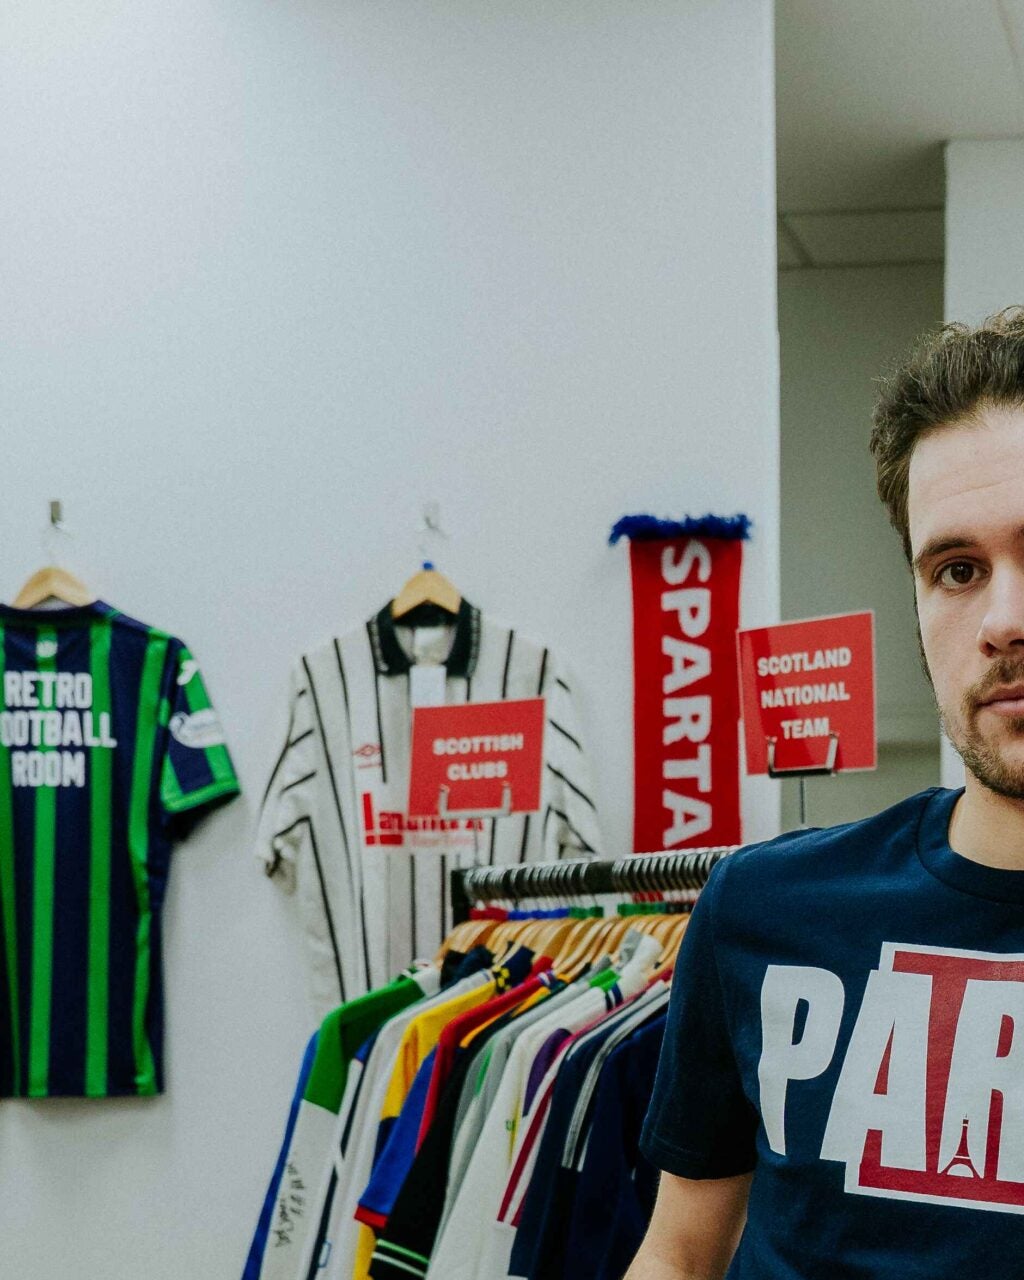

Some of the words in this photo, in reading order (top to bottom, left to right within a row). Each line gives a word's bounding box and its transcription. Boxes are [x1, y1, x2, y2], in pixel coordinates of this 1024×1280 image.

[757, 647, 852, 677] SCOTLAND
[4, 671, 93, 708] RETRO
[660, 539, 713, 848] SPARTA
[760, 681, 850, 709] NATIONAL
[0, 710, 118, 748] OOTBALL
[780, 717, 830, 740] TEAM
[432, 733, 524, 756] SCOTTISH
[11, 751, 86, 787] ROOM
[447, 761, 508, 781] CLUBS
